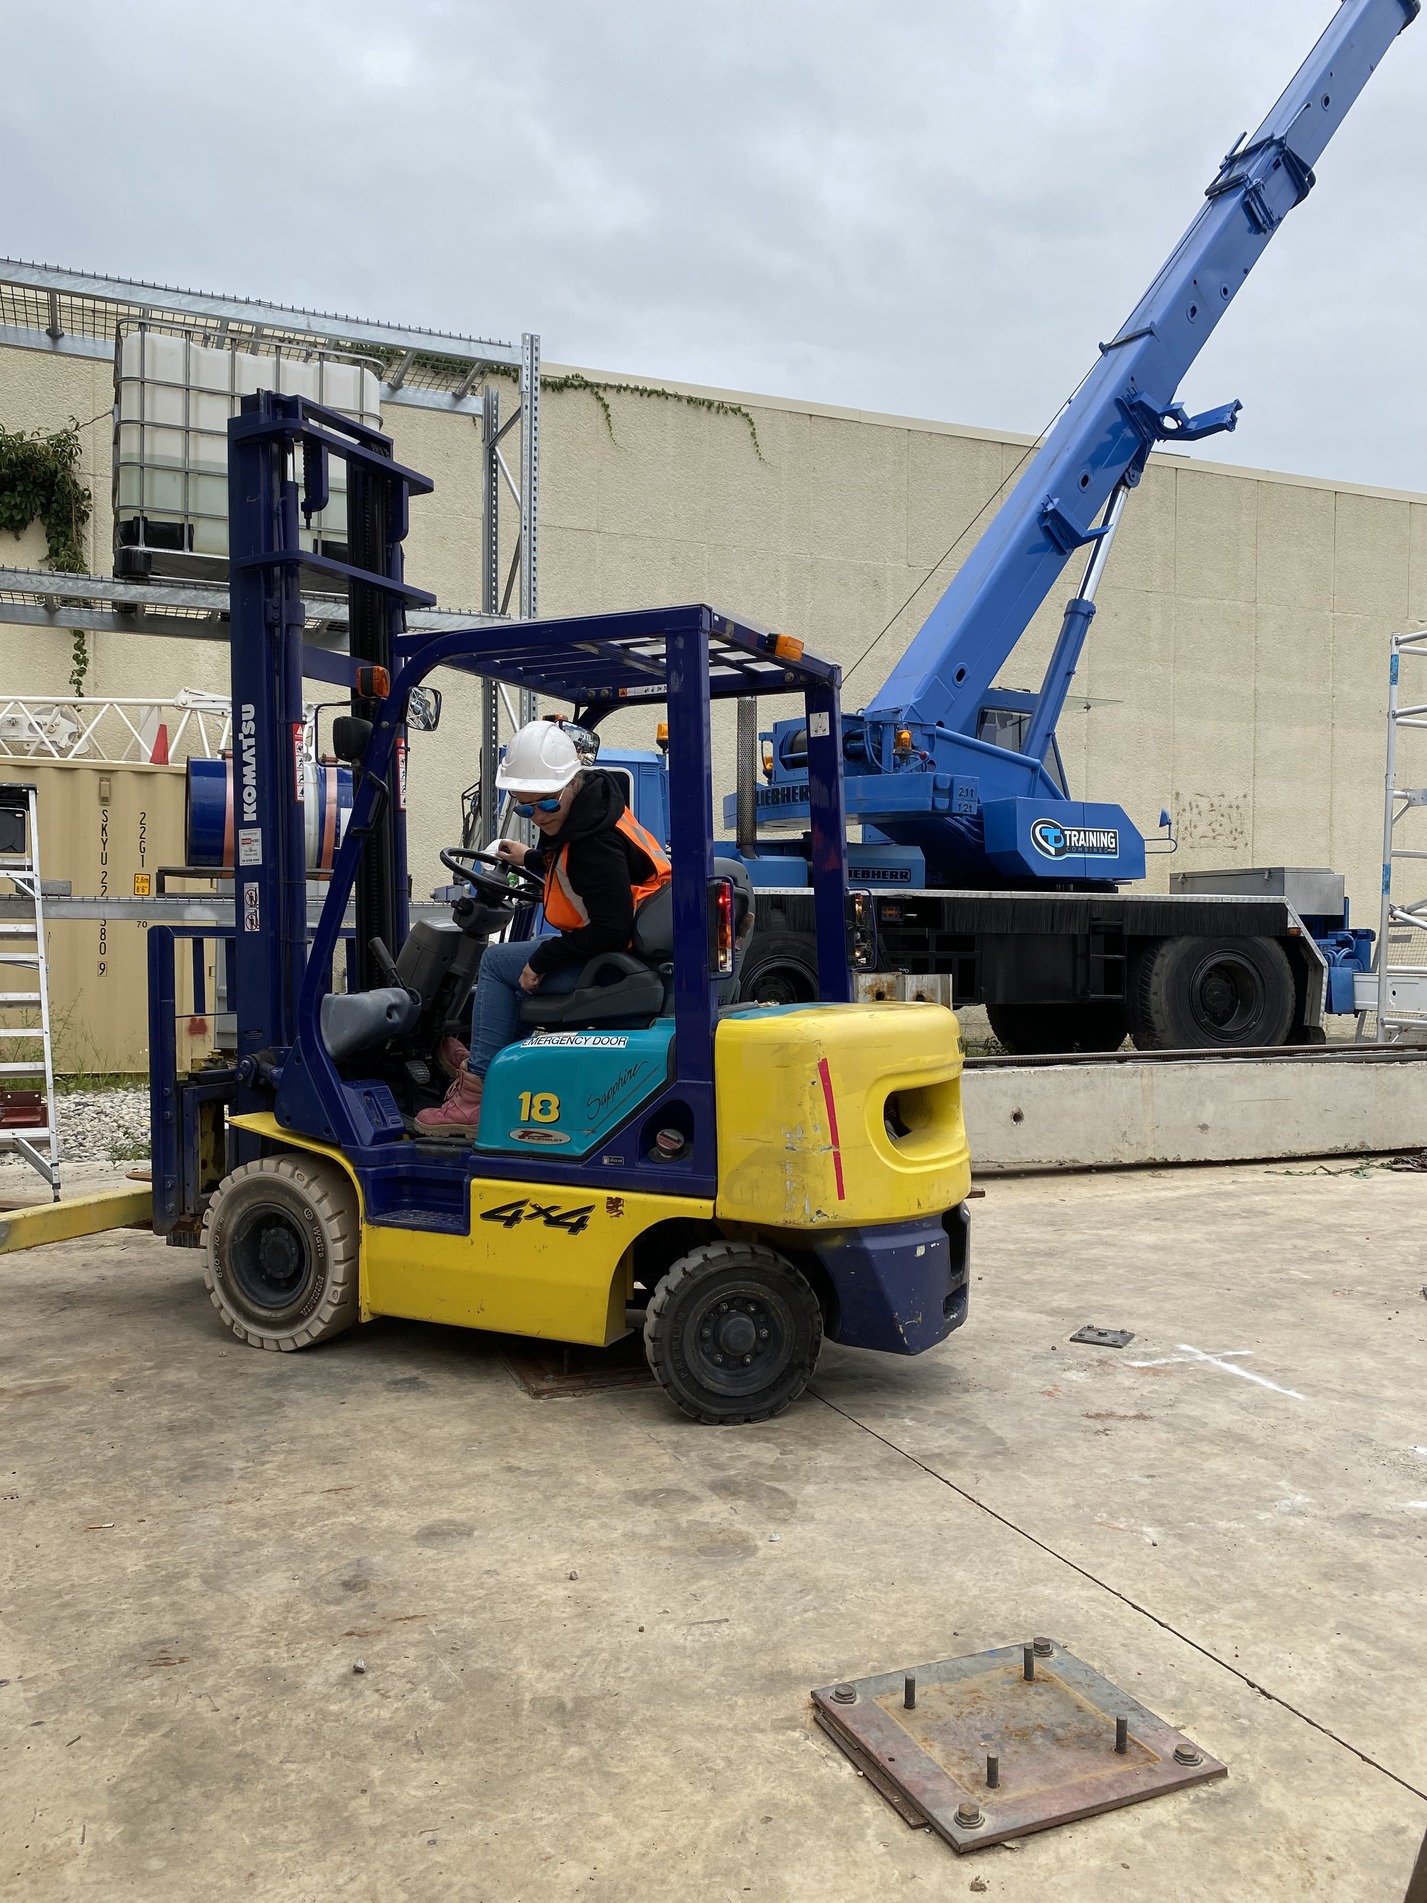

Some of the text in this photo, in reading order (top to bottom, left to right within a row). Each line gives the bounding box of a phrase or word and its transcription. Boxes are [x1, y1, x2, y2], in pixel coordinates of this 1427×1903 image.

[238, 703, 257, 821] KOMATSU
[756, 785, 810, 806] LIEBHER
[139, 811, 147, 868] 22G1
[1064, 830, 1116, 848] TRAINING
[1065, 846, 1108, 854] COMBINED
[848, 869, 909, 880] IEBHERR
[136, 920, 148, 928] 70
[522, 1036, 627, 1046] EMERGENCY DOOR
[587, 1060, 650, 1120] Sapphire
[518, 1091, 560, 1124] 18
